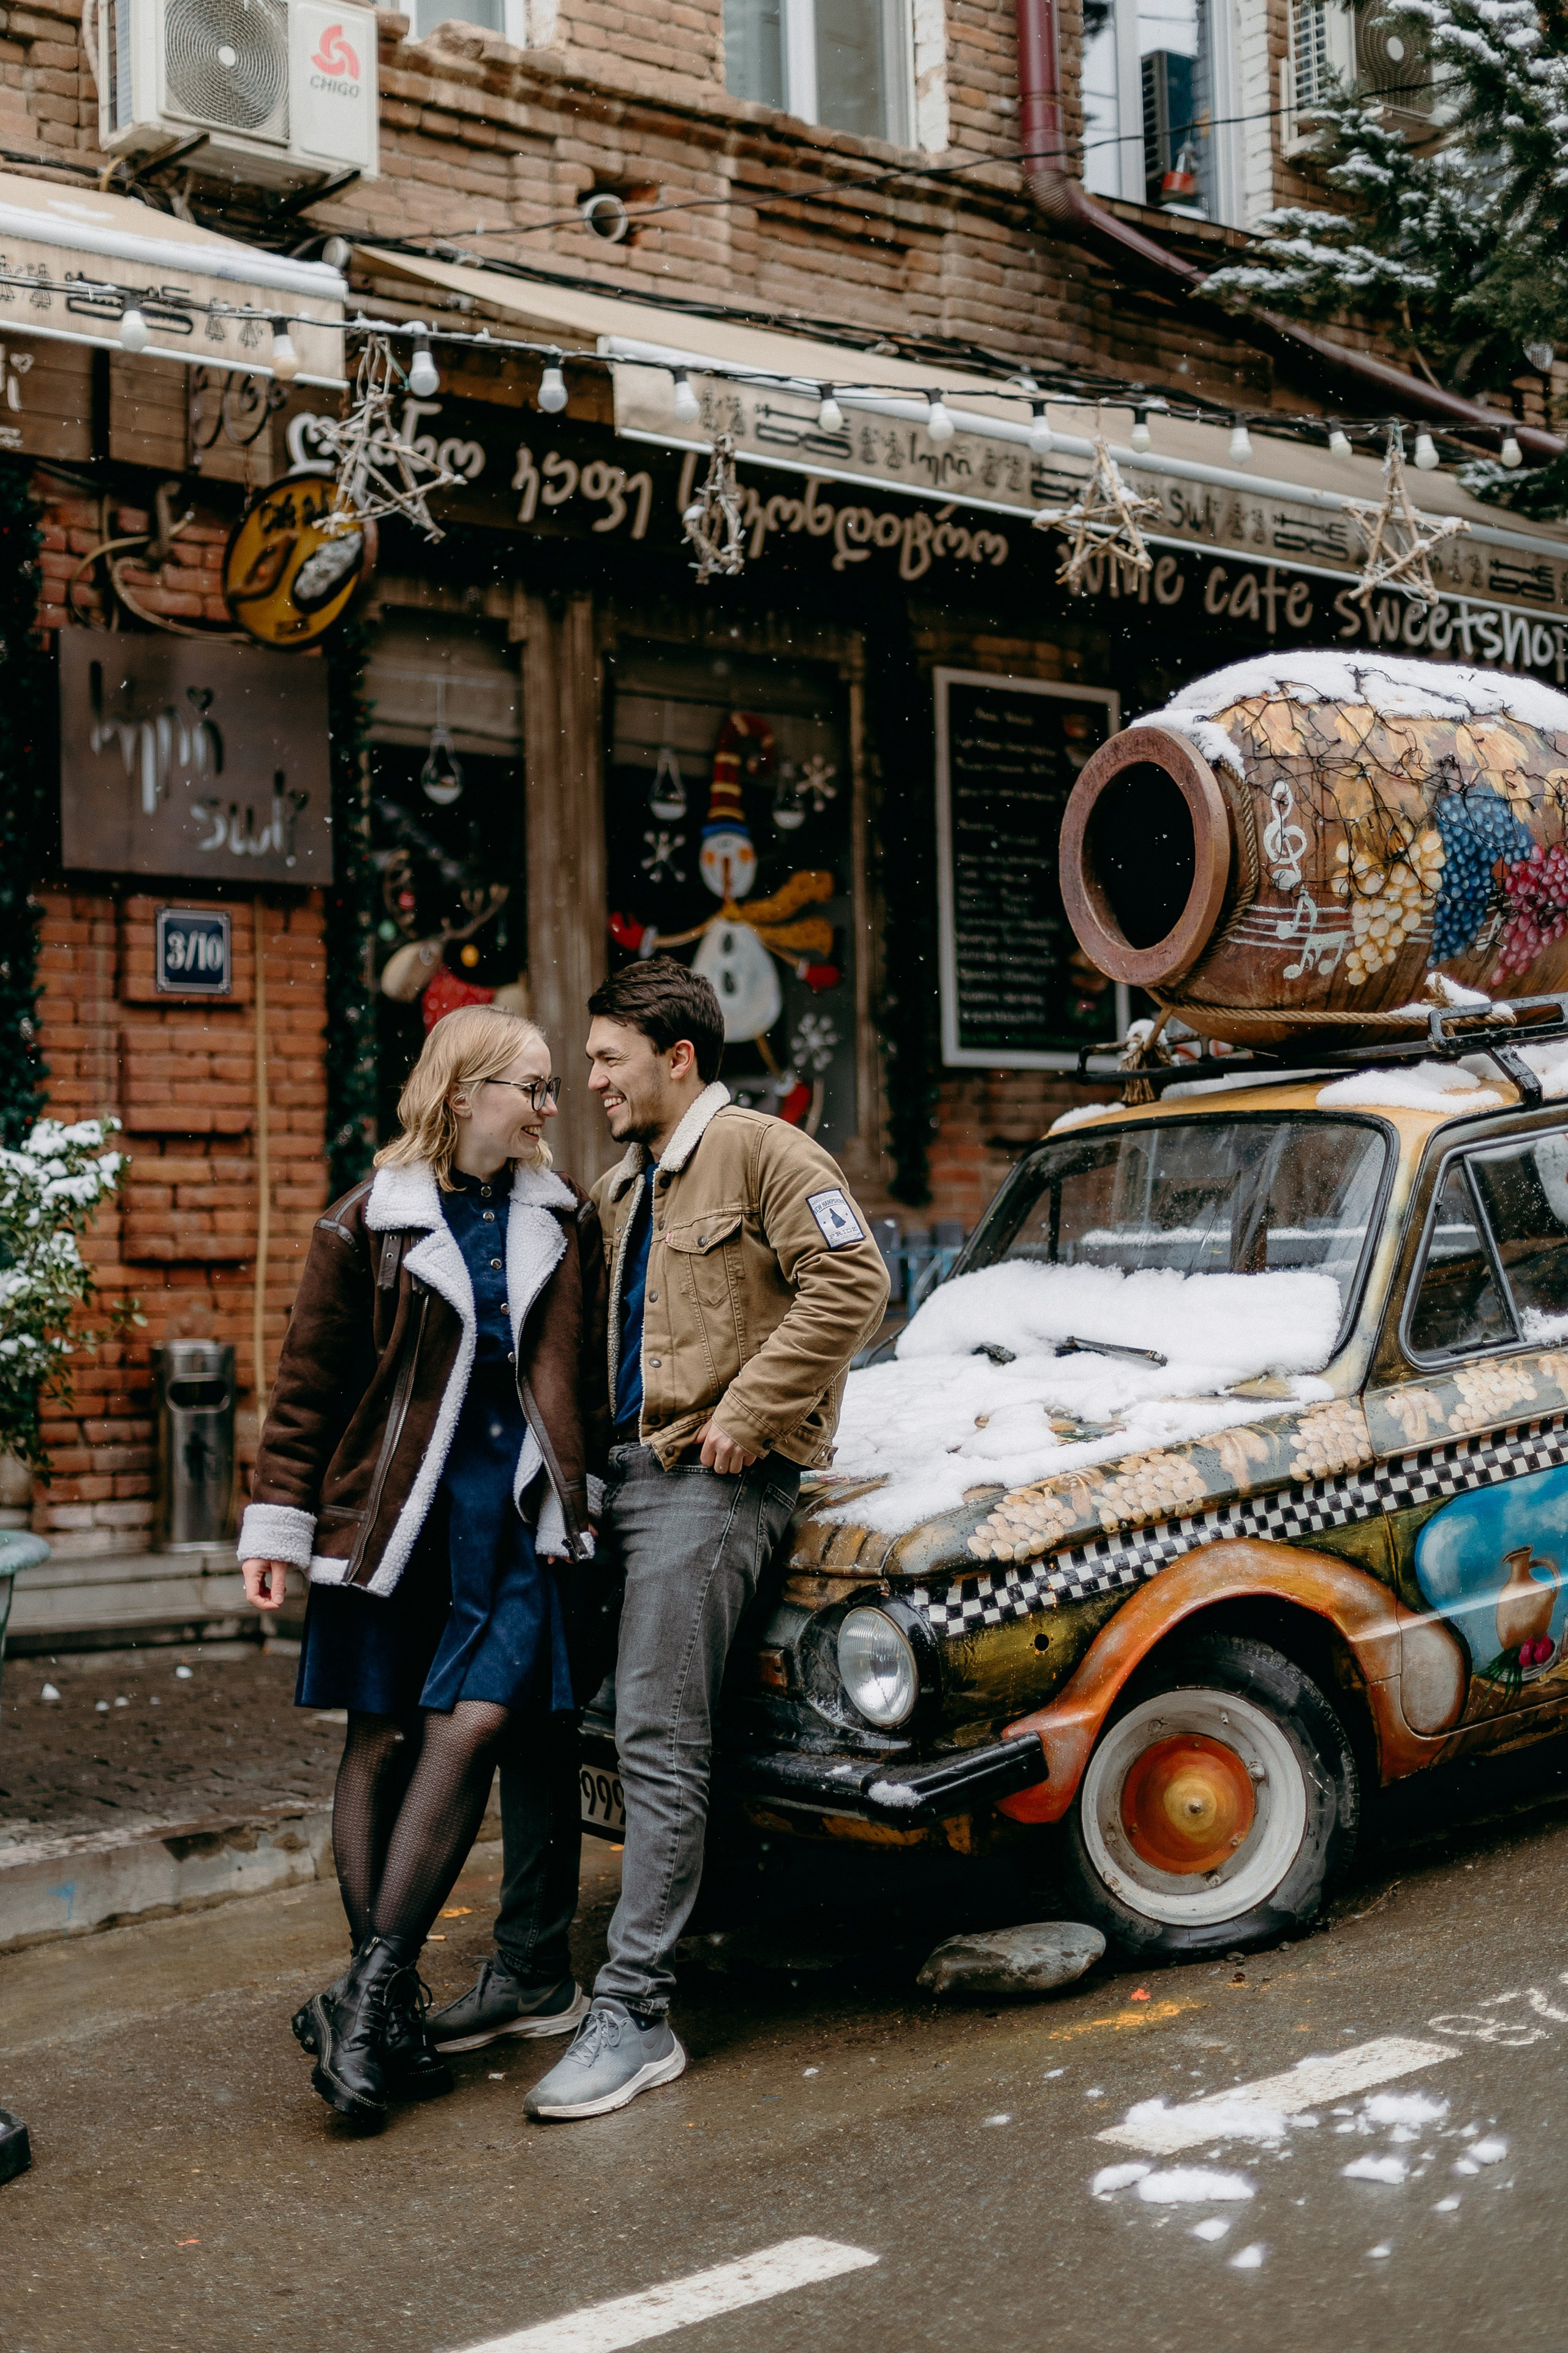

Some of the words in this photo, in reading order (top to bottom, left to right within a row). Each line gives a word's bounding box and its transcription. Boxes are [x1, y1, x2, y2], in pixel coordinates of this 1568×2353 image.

[310, 74, 360, 98] CHIGO
[1204, 566, 1313, 635] cafe
[166, 930, 224, 972] 3/10
[828, 1226, 858, 1240] PRIDE
